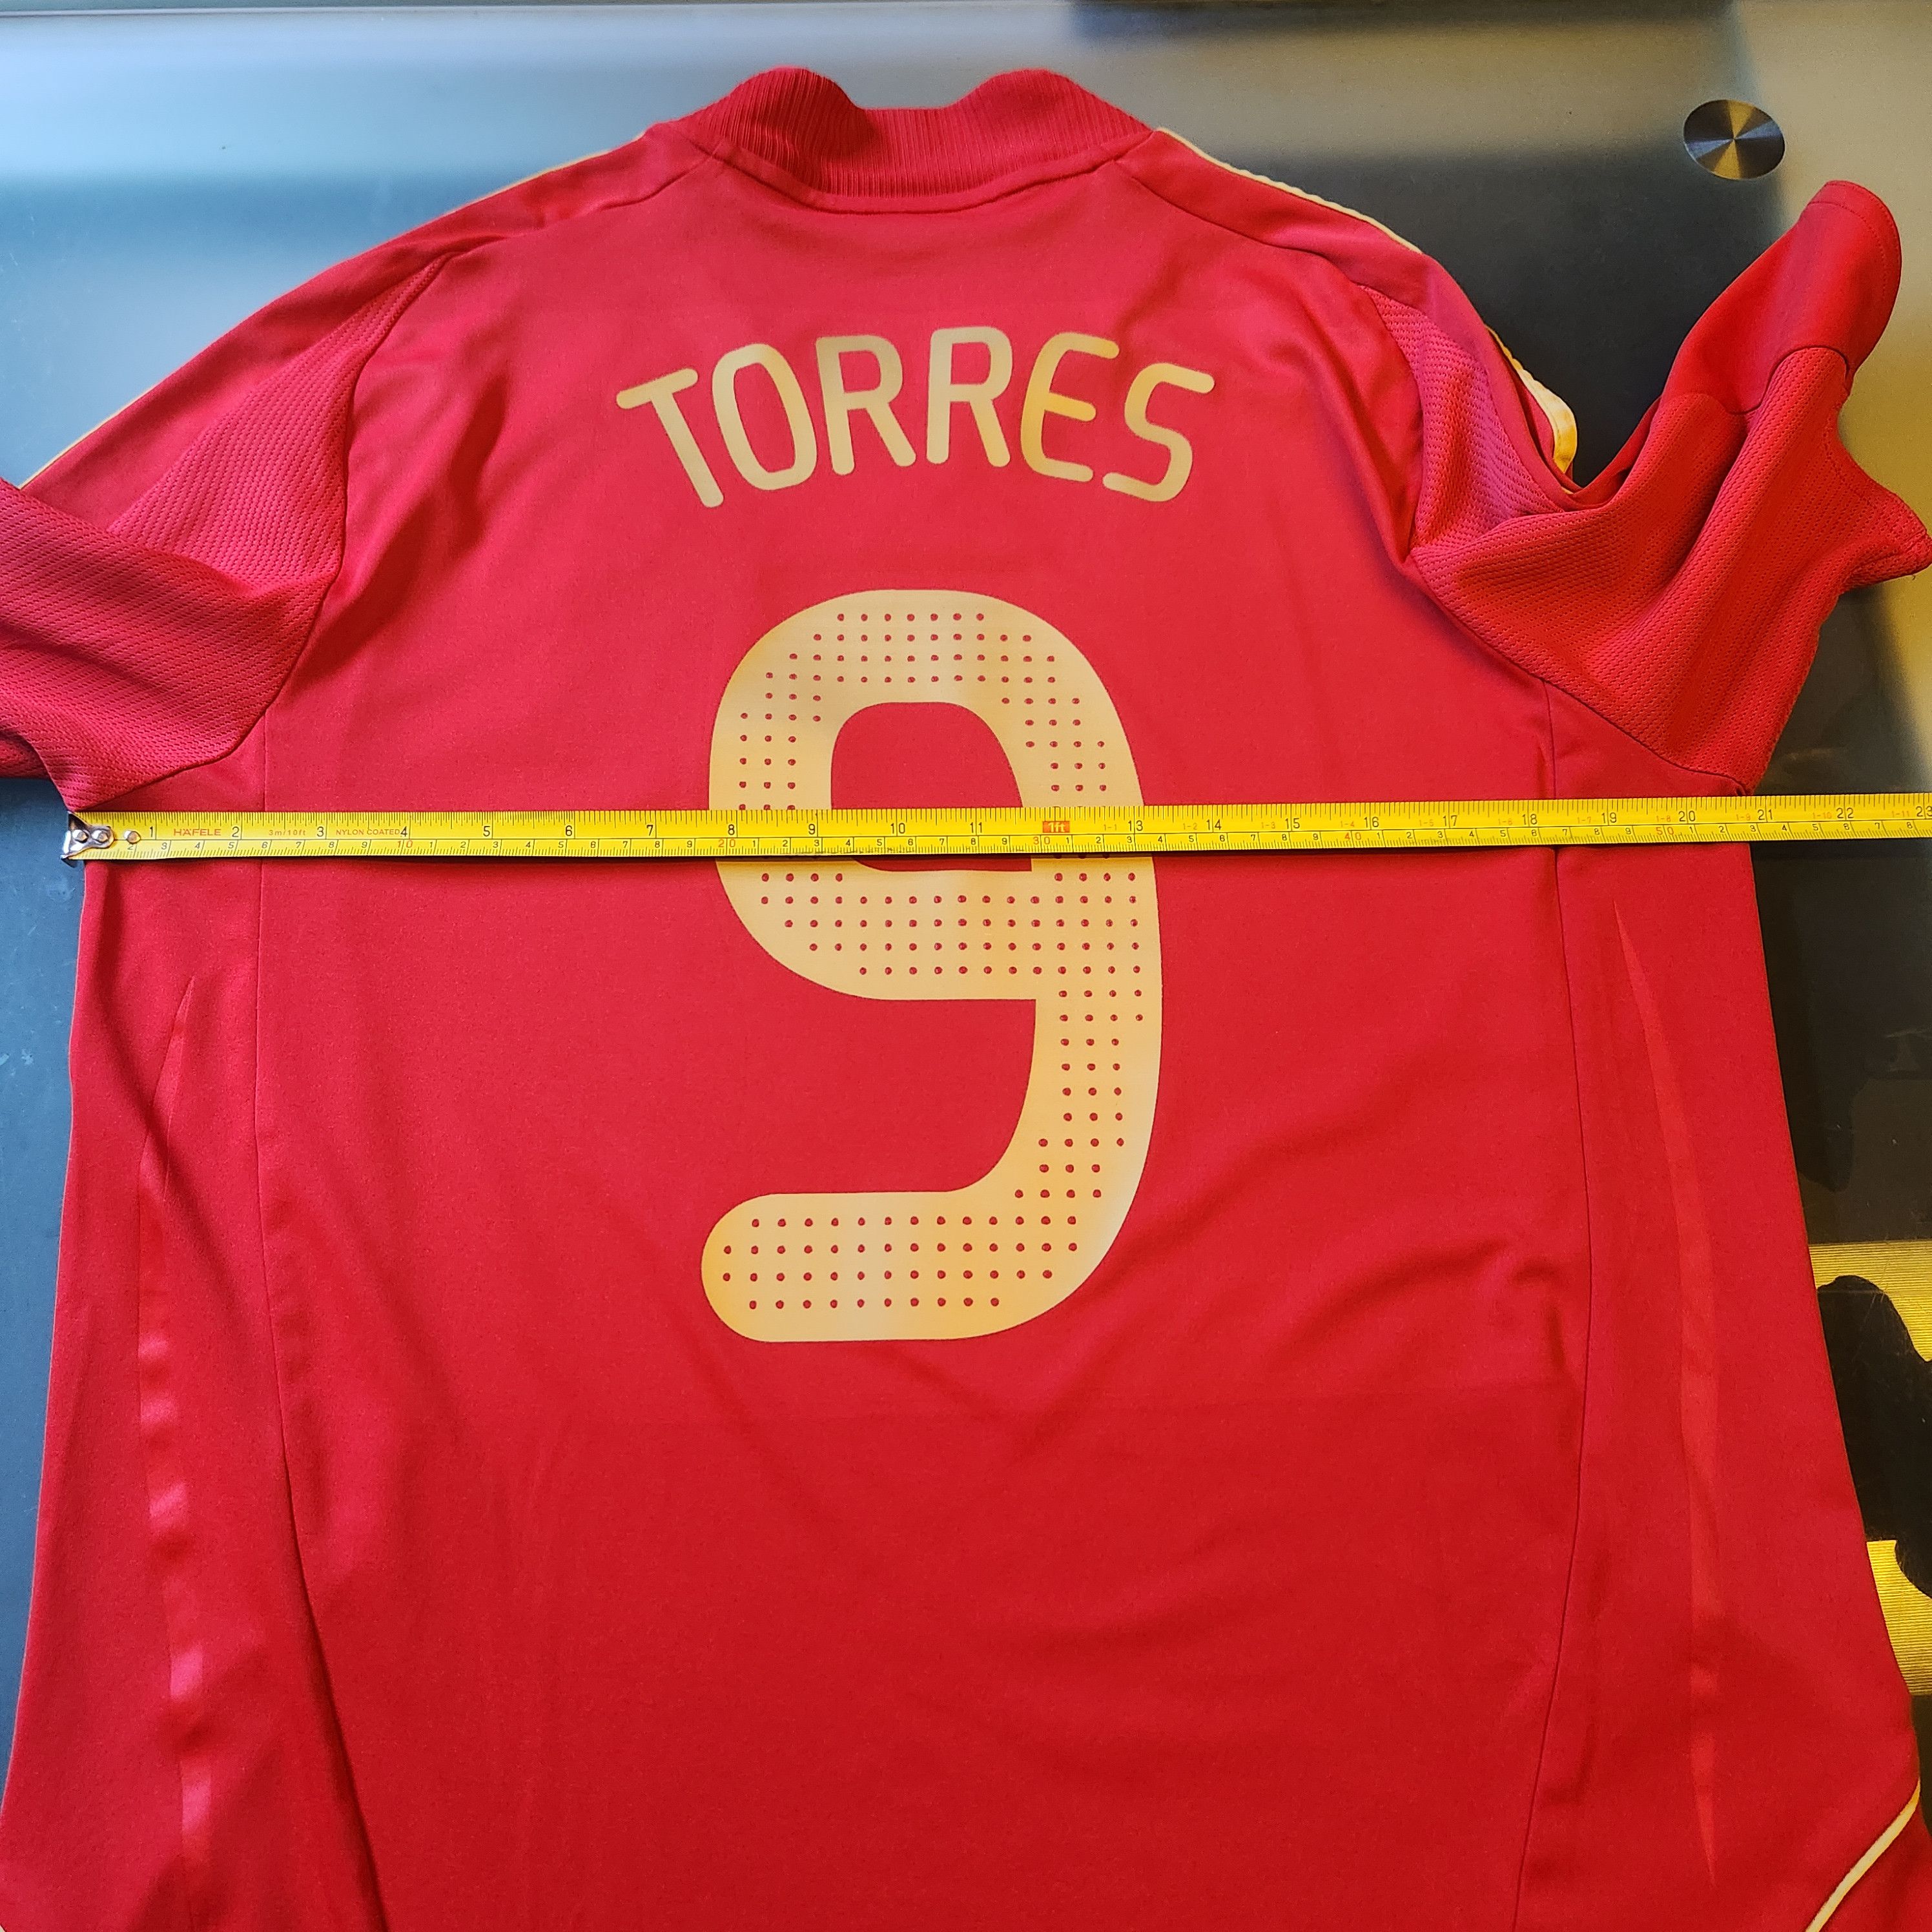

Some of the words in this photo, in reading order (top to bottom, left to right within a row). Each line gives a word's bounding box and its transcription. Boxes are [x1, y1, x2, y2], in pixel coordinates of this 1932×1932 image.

[617, 325, 1215, 508] TORRES
[150, 827, 153, 838] 1
[232, 826, 240, 838] 2
[316, 826, 324, 838] 3
[400, 826, 407, 837] 4
[483, 825, 491, 837] 5
[565, 825, 573, 836] 6
[646, 825, 653, 836] 7
[728, 824, 735, 836] 8
[808, 823, 816, 835] 9
[890, 823, 905, 834] 10
[970, 822, 982, 833] 11
[1047, 822, 1065, 832] 1ft
[1128, 820, 1143, 832] 13
[1206, 819, 1222, 830] 14
[1285, 817, 1300, 829] 15
[1364, 816, 1379, 828] 16
[1443, 815, 1457, 827] 17
[1522, 814, 1538, 825] 18
[1601, 812, 1617, 823] 19
[1679, 810, 1696, 822] 20
[1758, 809, 1773, 821] 21
[1836, 807, 1854, 819] 22
[718, 839, 736, 848] 20
[1344, 832, 1361, 840] 40
[1656, 827, 1674, 835] 50
[701, 589, 1162, 1342] 9
